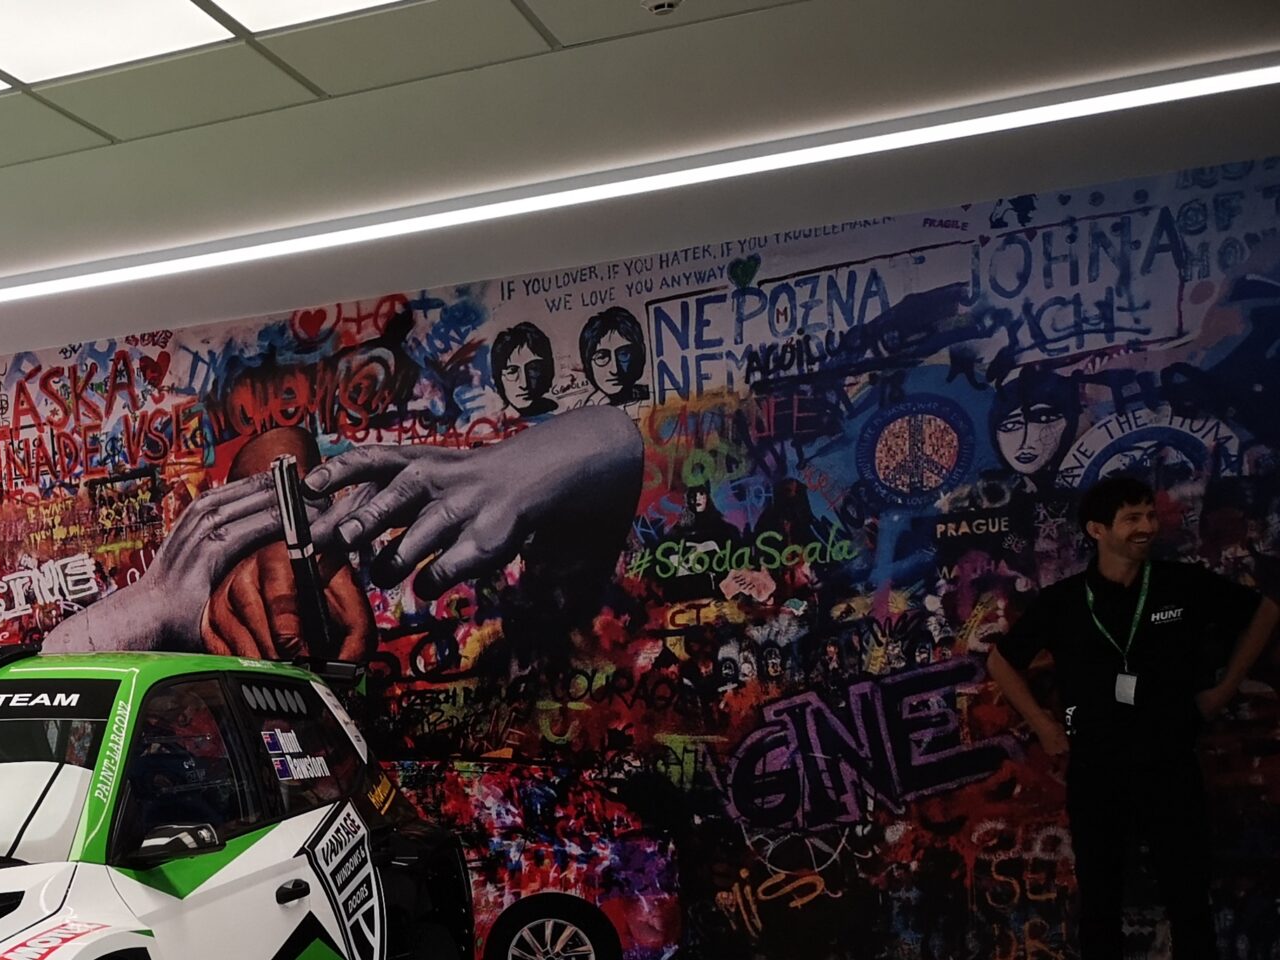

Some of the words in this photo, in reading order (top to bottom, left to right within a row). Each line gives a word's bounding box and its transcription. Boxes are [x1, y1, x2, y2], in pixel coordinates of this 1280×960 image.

[500, 279, 516, 301] IF
[522, 277, 552, 297] YOU
[607, 264, 619, 280] IF
[624, 258, 654, 277] YOU
[737, 235, 768, 254] YOU
[545, 293, 572, 313] WE
[581, 287, 616, 307] LOVE
[625, 278, 654, 297] YOU
[658, 264, 727, 290] ANYWAY
[936, 517, 1009, 539] PRAGUE
[1150, 608, 1184, 622] HUNT
[321, 811, 362, 868] VANTAGE
[347, 883, 369, 914] DOORS
